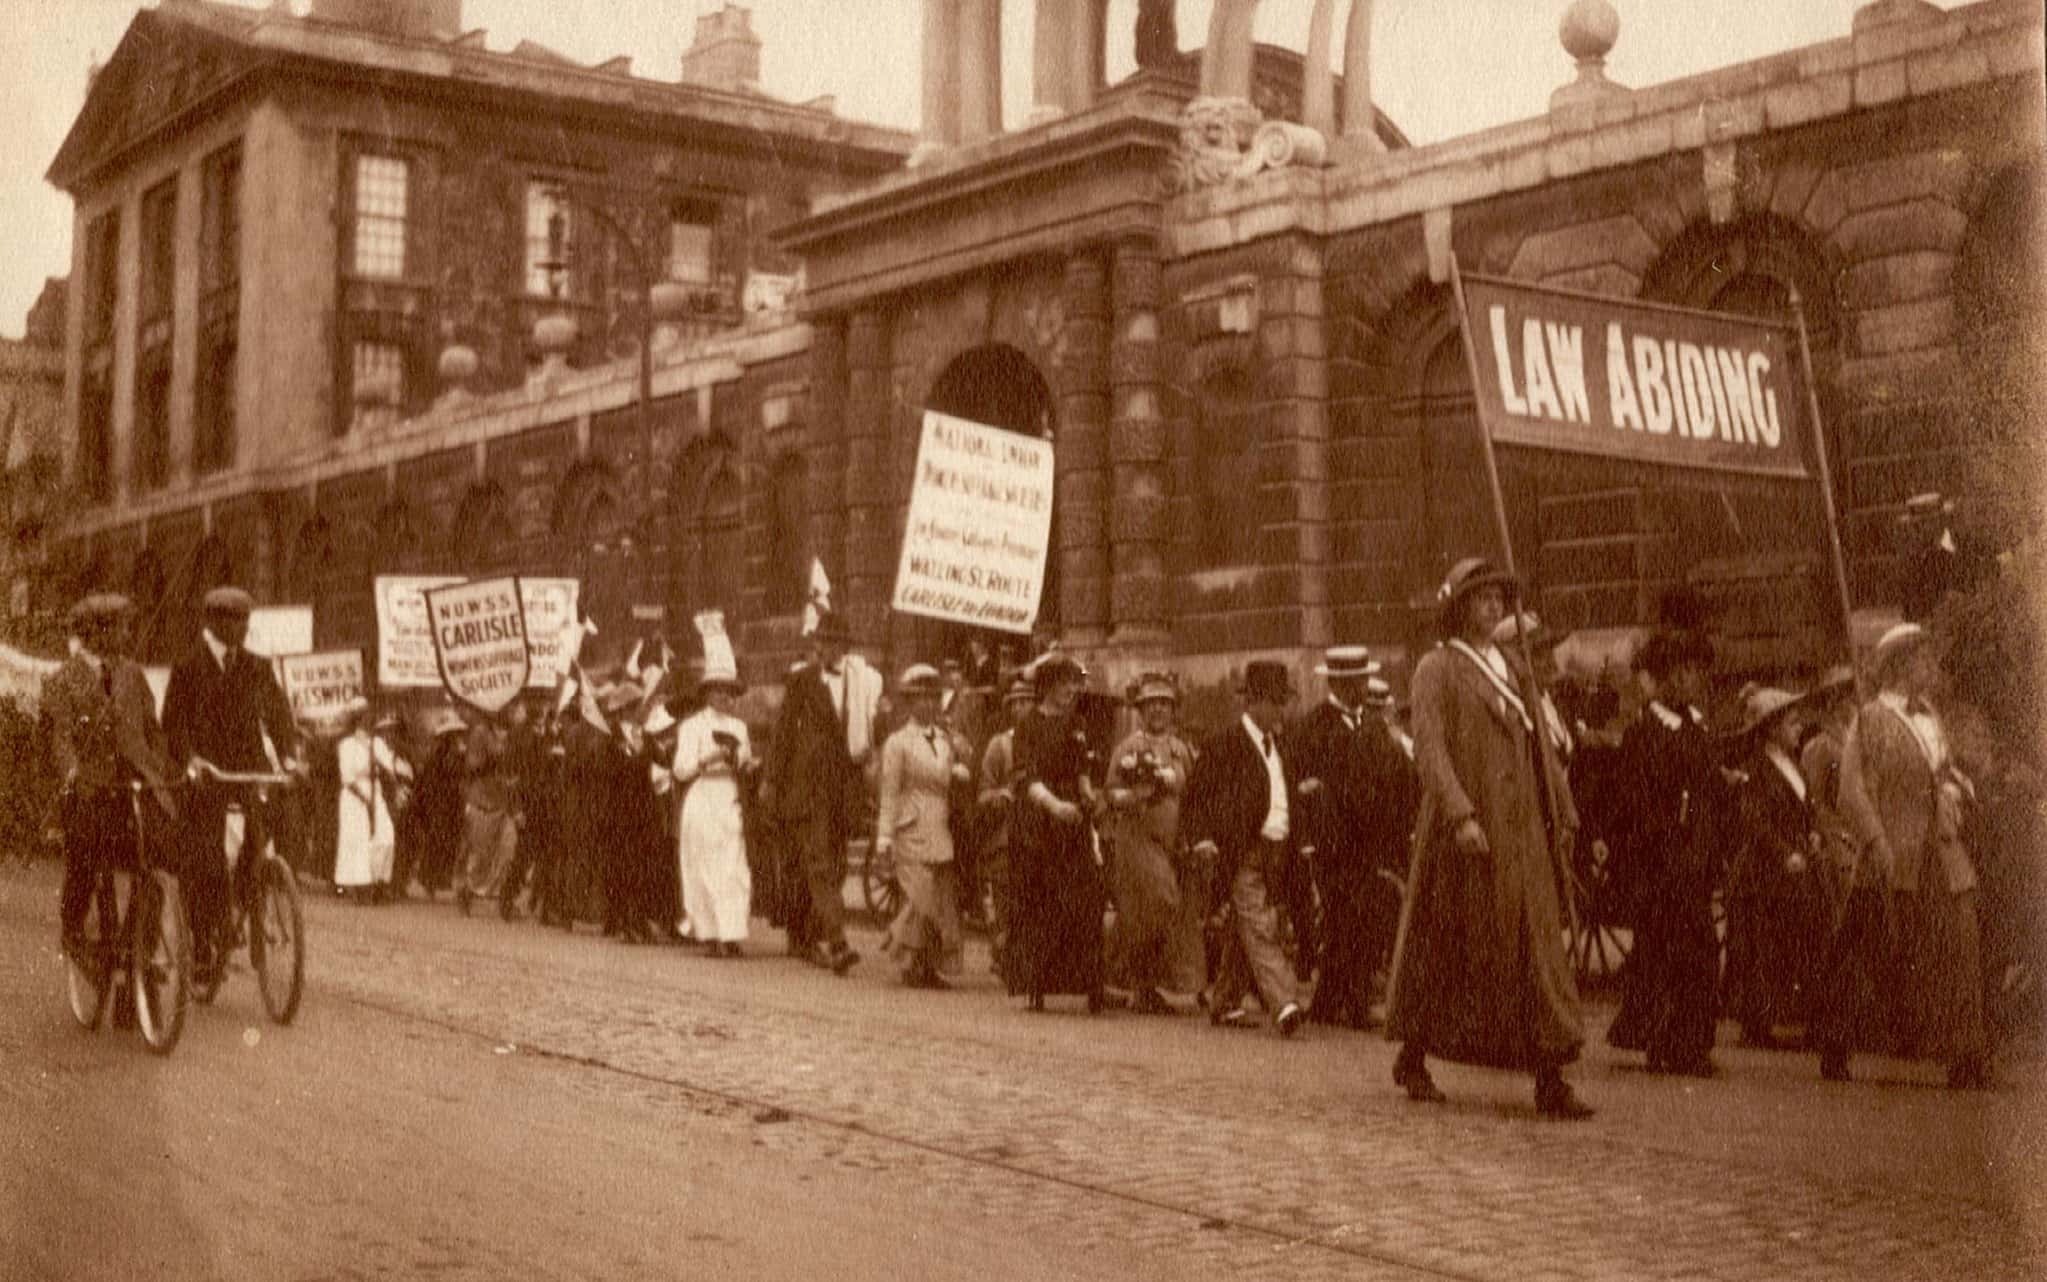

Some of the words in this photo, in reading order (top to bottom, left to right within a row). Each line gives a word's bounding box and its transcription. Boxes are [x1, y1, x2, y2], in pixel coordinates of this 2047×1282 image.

[1489, 305, 1591, 424] LAW
[1607, 321, 1780, 448] ABIDING
[441, 613, 521, 650] CARLISLE
[460, 670, 513, 694] SOCIETY
